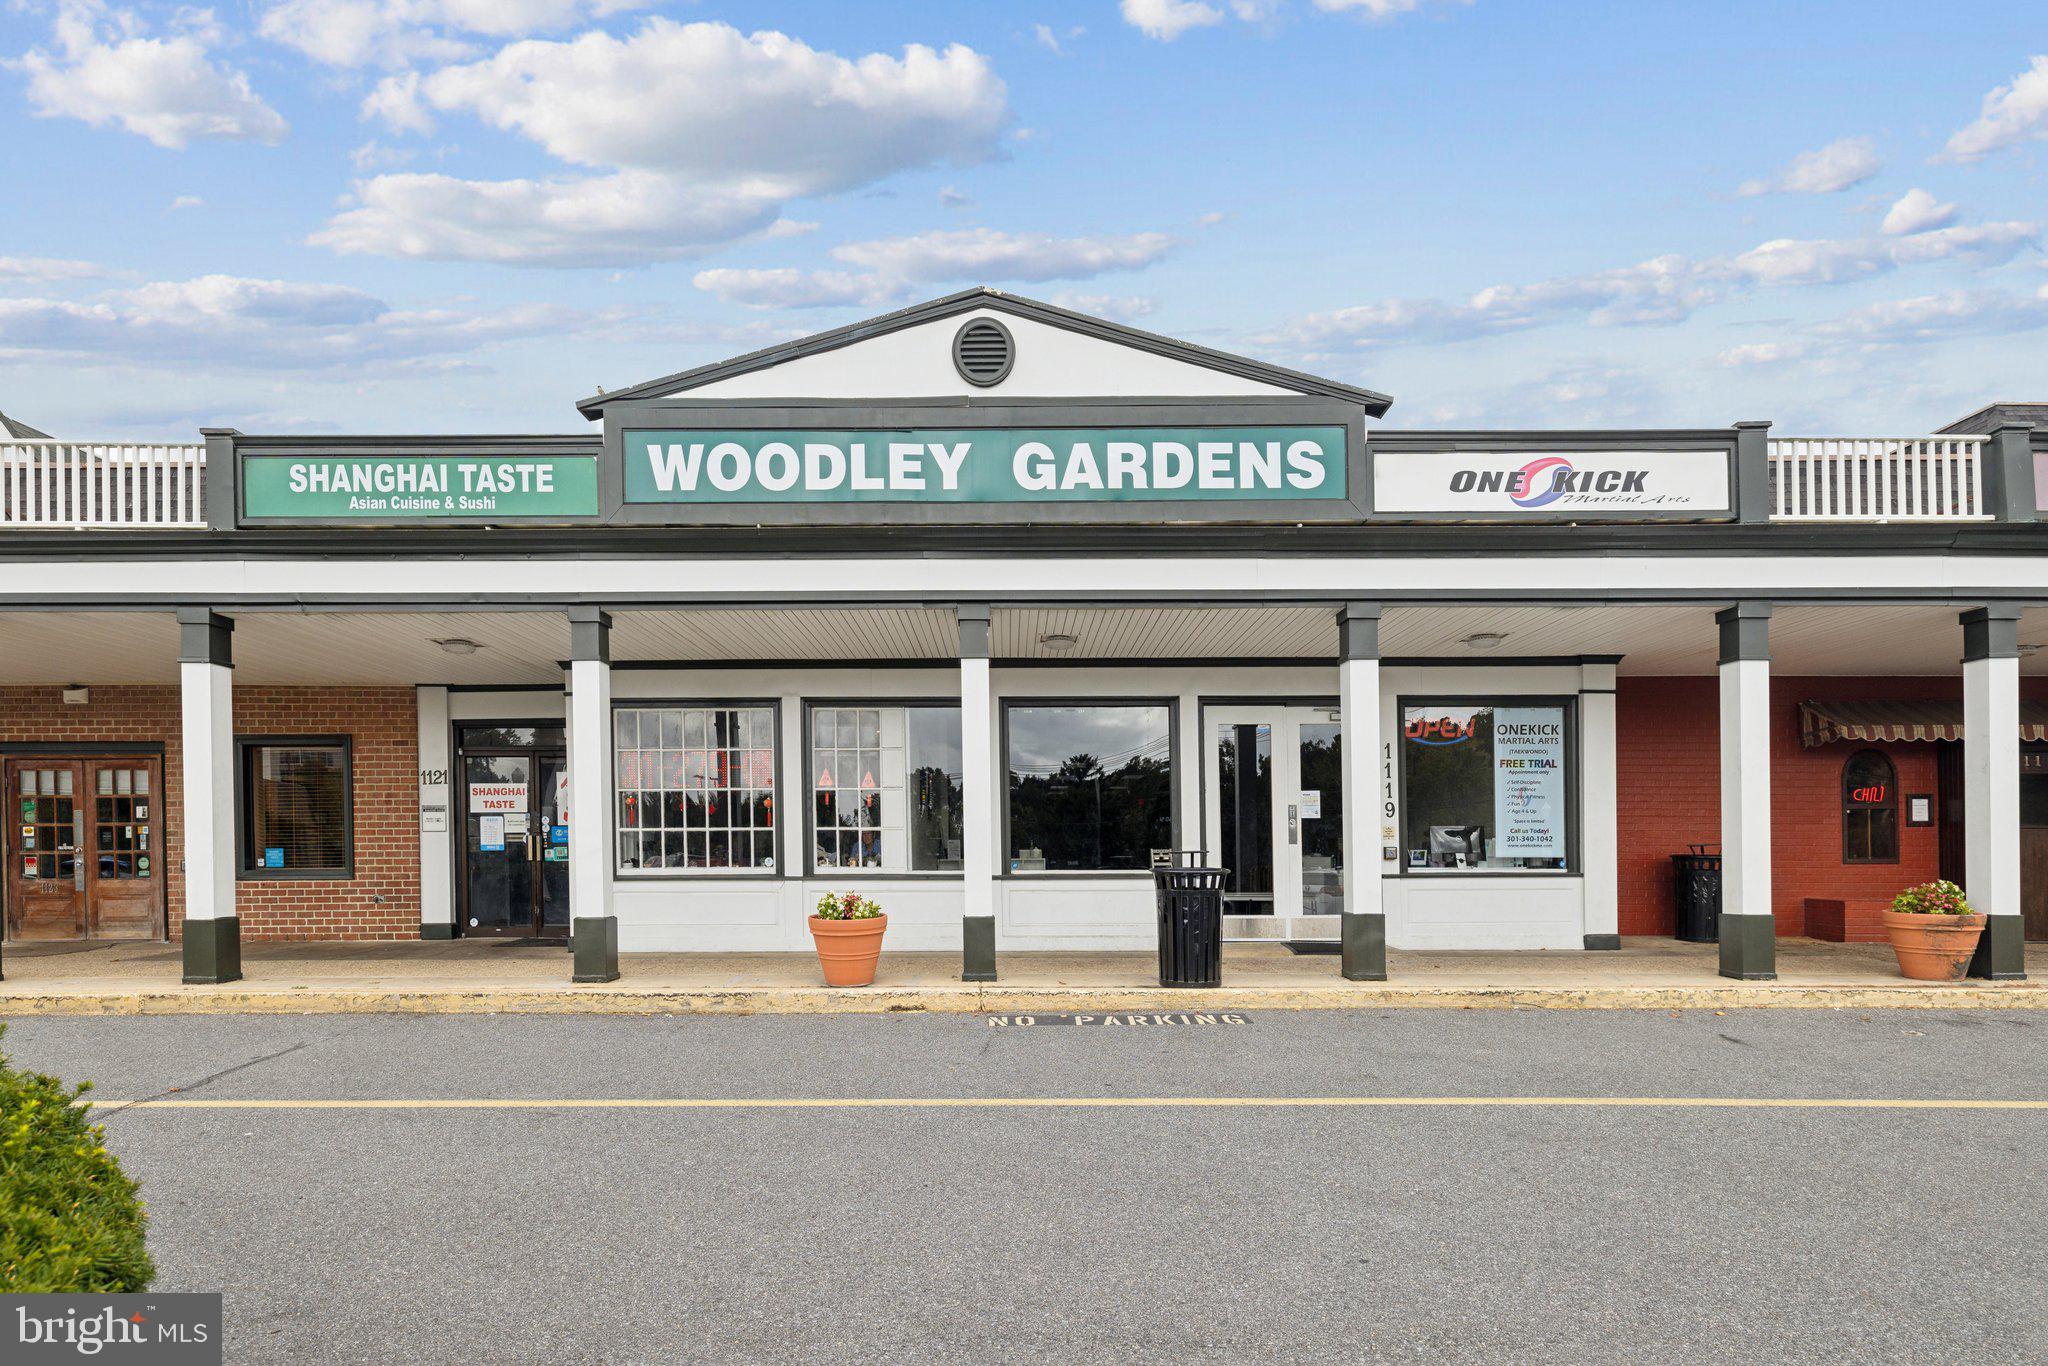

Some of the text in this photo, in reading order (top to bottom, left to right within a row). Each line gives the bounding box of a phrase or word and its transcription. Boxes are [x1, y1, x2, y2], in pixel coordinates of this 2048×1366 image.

[646, 440, 1326, 491] WOODLEY GARDENS
[289, 464, 554, 493] SHANGHAI TASTE
[1449, 470, 1650, 493] ONE KICK
[349, 496, 496, 510] Asian Cuisine & Sushi
[1562, 494, 1692, 505] Martial Arts
[1405, 717, 1476, 738] OPEN
[1497, 724, 1559, 735] ONEKICK
[1498, 737, 1559, 745] MARTIAL ARTS
[1500, 759, 1558, 768] FREE TRIAL
[421, 769, 449, 785] 1121
[1384, 742, 1396, 818] 1119
[472, 787, 526, 796] SHANGHAI
[1853, 785, 1886, 802] CHILI
[483, 800, 516, 809] TASTE
[988, 1013, 1247, 1027] NO PARKING
